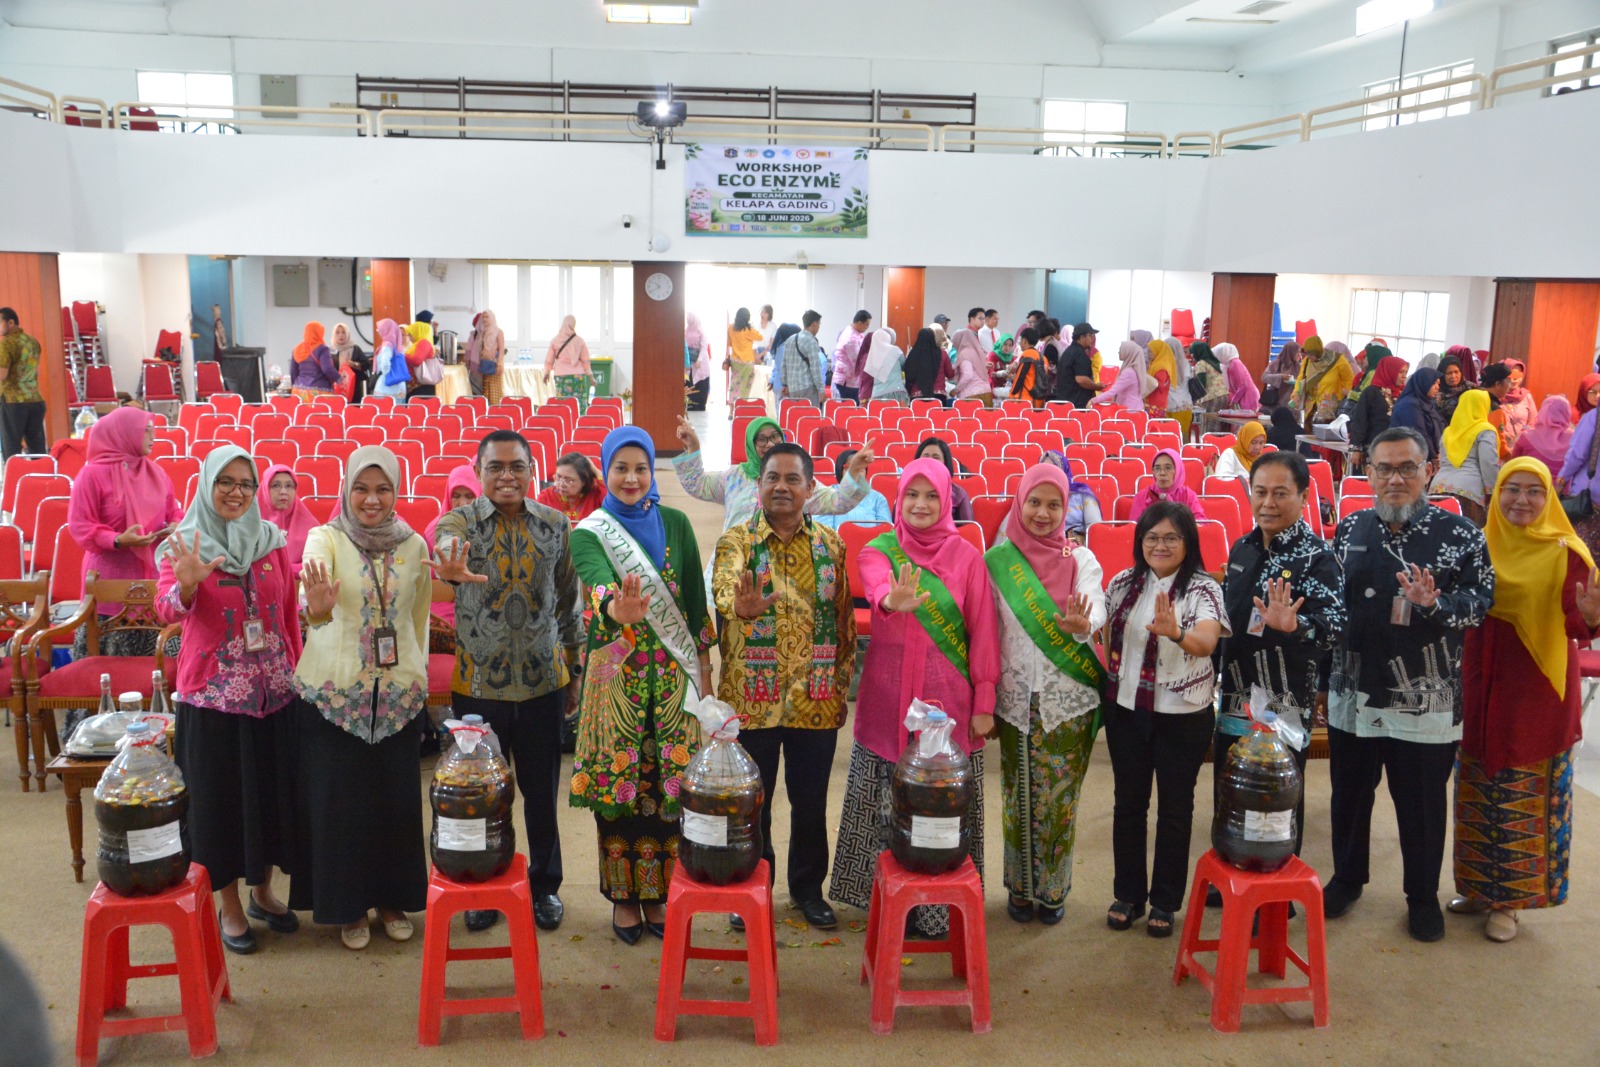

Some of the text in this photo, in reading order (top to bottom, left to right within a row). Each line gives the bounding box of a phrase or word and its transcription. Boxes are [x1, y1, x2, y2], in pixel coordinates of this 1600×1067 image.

[736, 162, 822, 173] WORKSHOP
[717, 174, 756, 187] ECO
[762, 174, 840, 188] ENZYME
[726, 200, 828, 210] KELAPA GADING
[768, 214, 788, 222] JUNI
[790, 214, 810, 222] 2026
[595, 519, 634, 565] DUTA
[649, 597, 696, 664] ENZYME
[1009, 563, 1028, 589] PIC
[1023, 586, 1064, 646] Workshop
[1062, 642, 1081, 664] Eco
[942, 623, 958, 646] Eco
